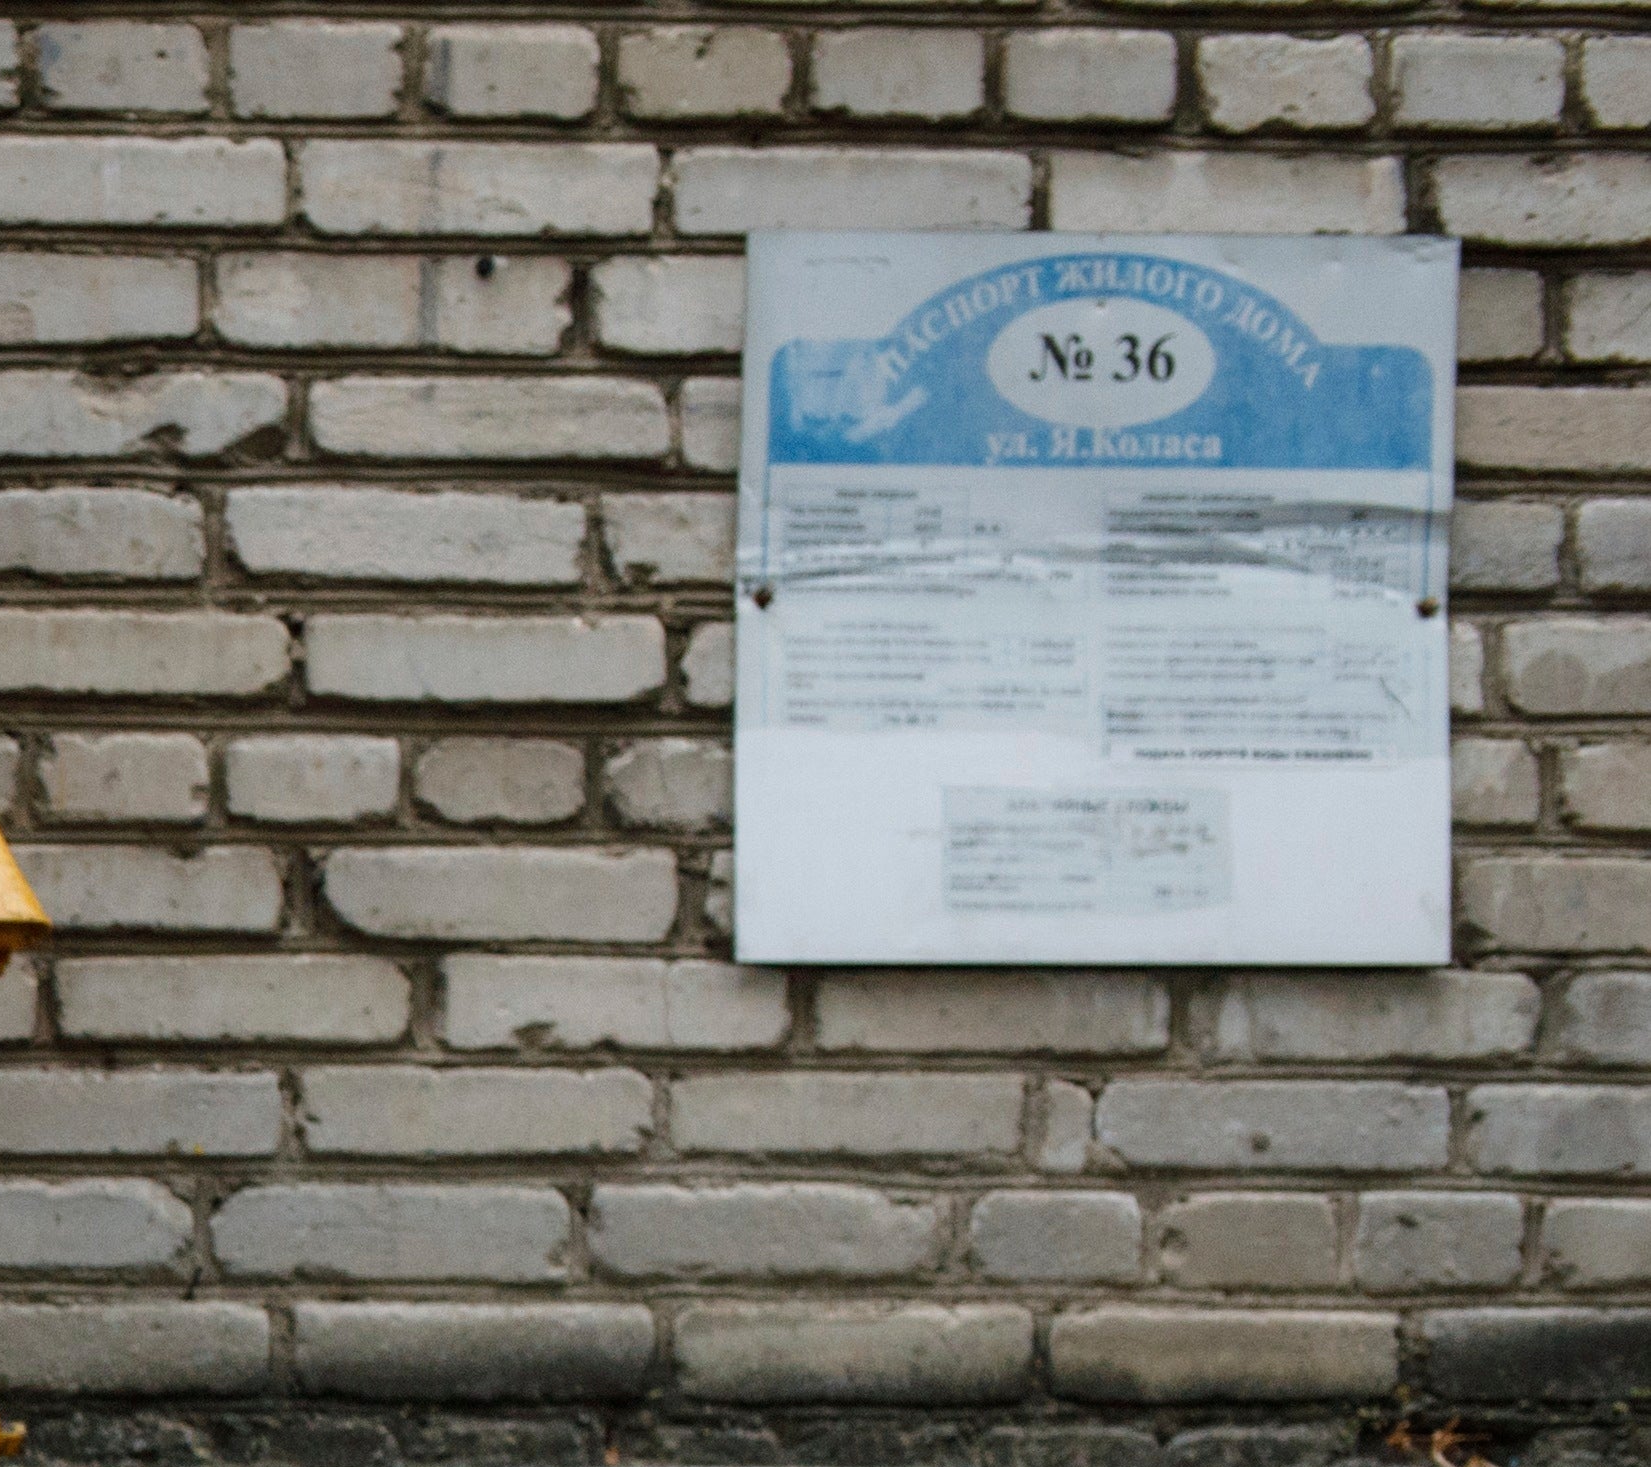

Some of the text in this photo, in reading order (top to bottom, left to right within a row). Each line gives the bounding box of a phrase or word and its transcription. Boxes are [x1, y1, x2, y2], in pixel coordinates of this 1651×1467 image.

[875, 260, 1324, 391] ПАСПОРТ ЖИЛОГО ДОМА
[1030, 330, 1179, 382] № 36
[985, 426, 1223, 466] ул. Я.Коласа
